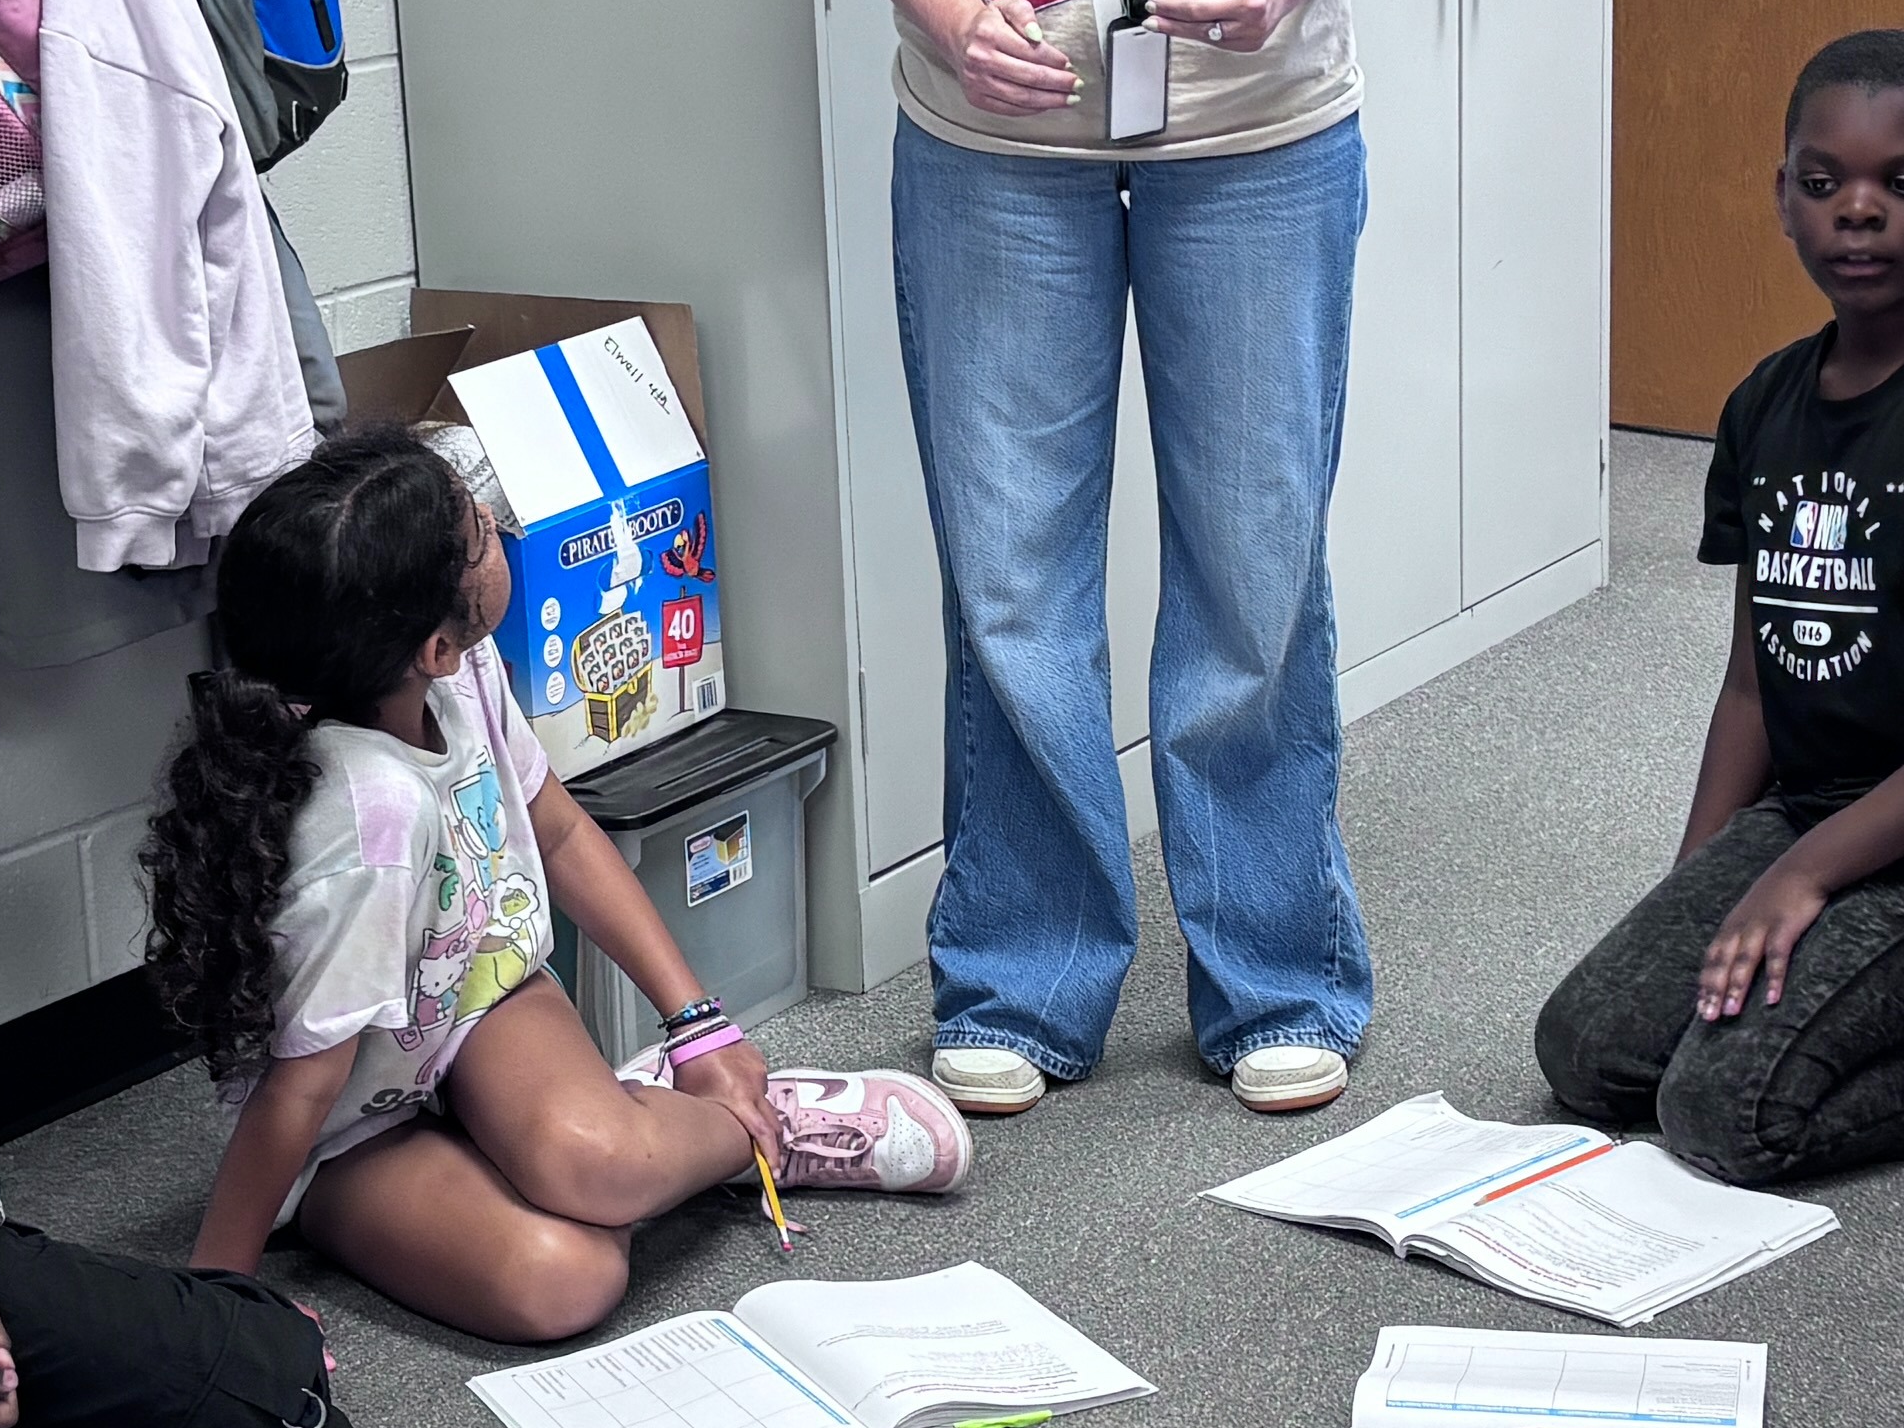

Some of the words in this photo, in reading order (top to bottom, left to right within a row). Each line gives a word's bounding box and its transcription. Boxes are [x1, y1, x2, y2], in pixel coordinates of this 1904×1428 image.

[629, 505, 674, 539] BOOTY
[1758, 471, 1881, 540] NATIONAL
[1814, 504, 1849, 551] NBA
[1756, 549, 1877, 591] BASKETBALL
[668, 608, 696, 641] 40
[1759, 621, 1873, 681] ASSOCIATION
